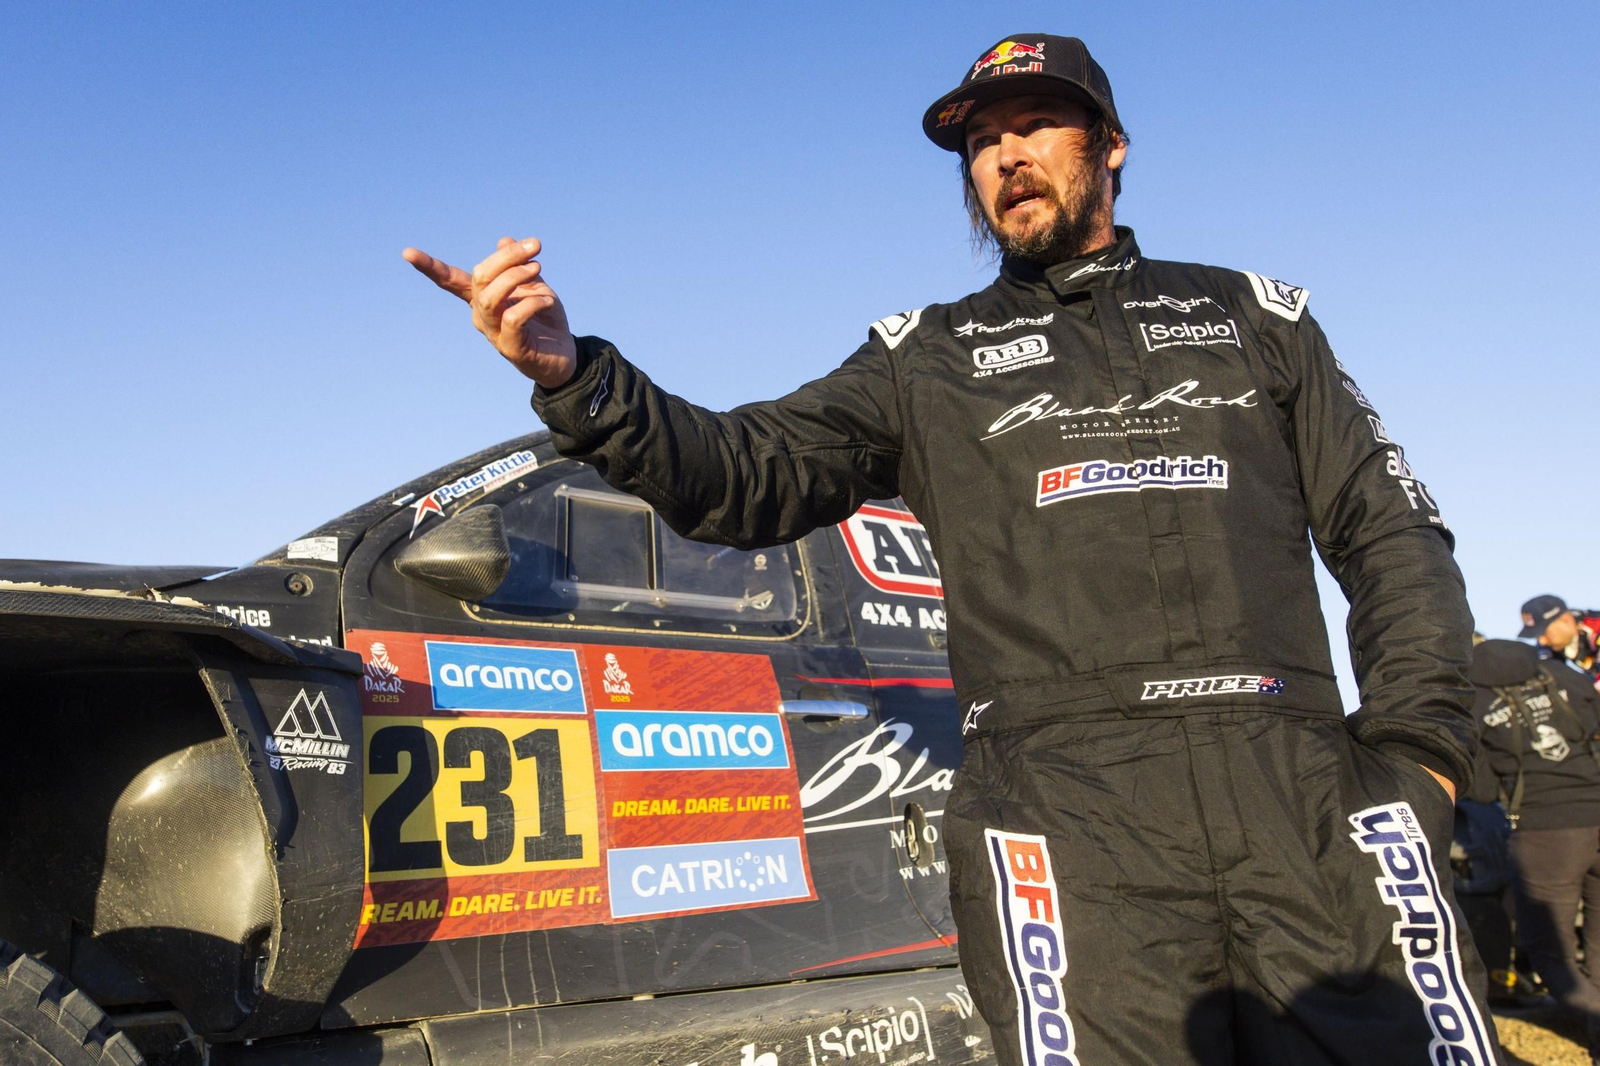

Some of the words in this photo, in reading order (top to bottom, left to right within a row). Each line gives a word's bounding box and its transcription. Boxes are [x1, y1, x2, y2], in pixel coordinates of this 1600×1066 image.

[1149, 322, 1231, 341] Scipio
[983, 340, 1041, 365] ARB
[1137, 378, 1258, 410] Rock
[1060, 421, 1110, 431] MOTOR
[437, 471, 487, 501] Peter
[486, 452, 532, 477] Kittle
[1040, 457, 1225, 496] BFGoodrich
[364, 676, 405, 694] DAKAR
[440, 663, 574, 692] aramco
[602, 679, 634, 695] DAKAR
[1141, 675, 1262, 701] PRICE
[372, 694, 400, 703] 2025
[610, 694, 631, 702] 2025
[611, 722, 774, 757] aramco
[269, 757, 281, 771] 23
[327, 762, 347, 775] 83
[369, 725, 584, 873] 231
[612, 799, 682, 817] DREAM.
[684, 796, 734, 814] DARE.
[737, 795, 771, 812] LIVE
[773, 795, 791, 810] IT.
[1396, 807, 1422, 842] Tires
[360, 898, 444, 925] REAM.
[449, 892, 520, 917] DARE.
[525, 889, 574, 911] LIVE
[577, 886, 603, 906] IT.
[819, 1007, 920, 1064] Scipio
